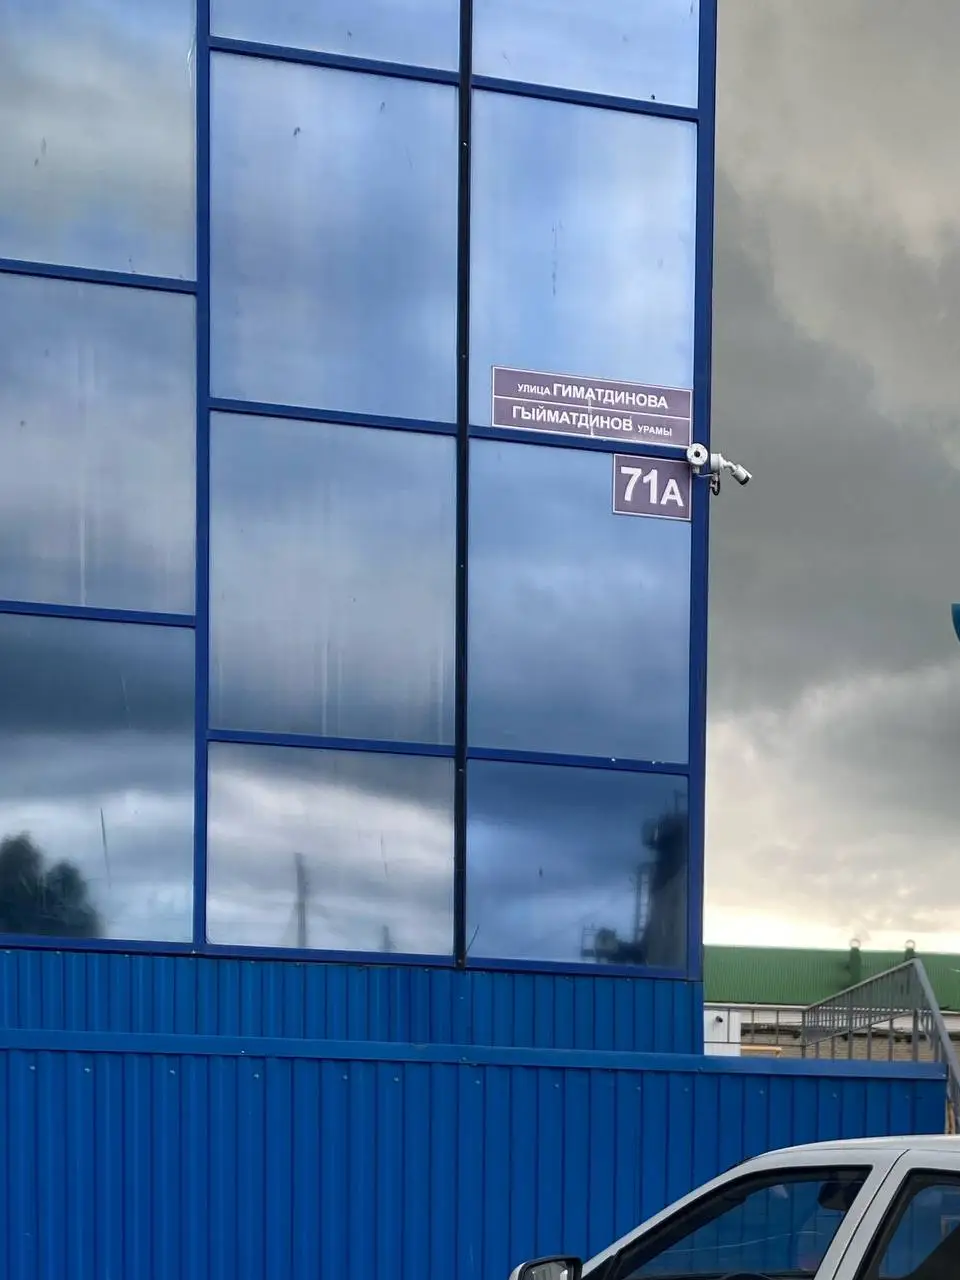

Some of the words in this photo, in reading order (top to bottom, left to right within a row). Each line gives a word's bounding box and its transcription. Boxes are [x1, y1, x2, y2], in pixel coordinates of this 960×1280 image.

[517, 383, 551, 396] УЛИЦА
[553, 383, 669, 409] ГИМАТДИНОВА
[512, 405, 633, 432] ГЫЙМАТДИНОВ
[637, 424, 672, 437] УРАМЫ
[620, 466, 684, 507] 71А
